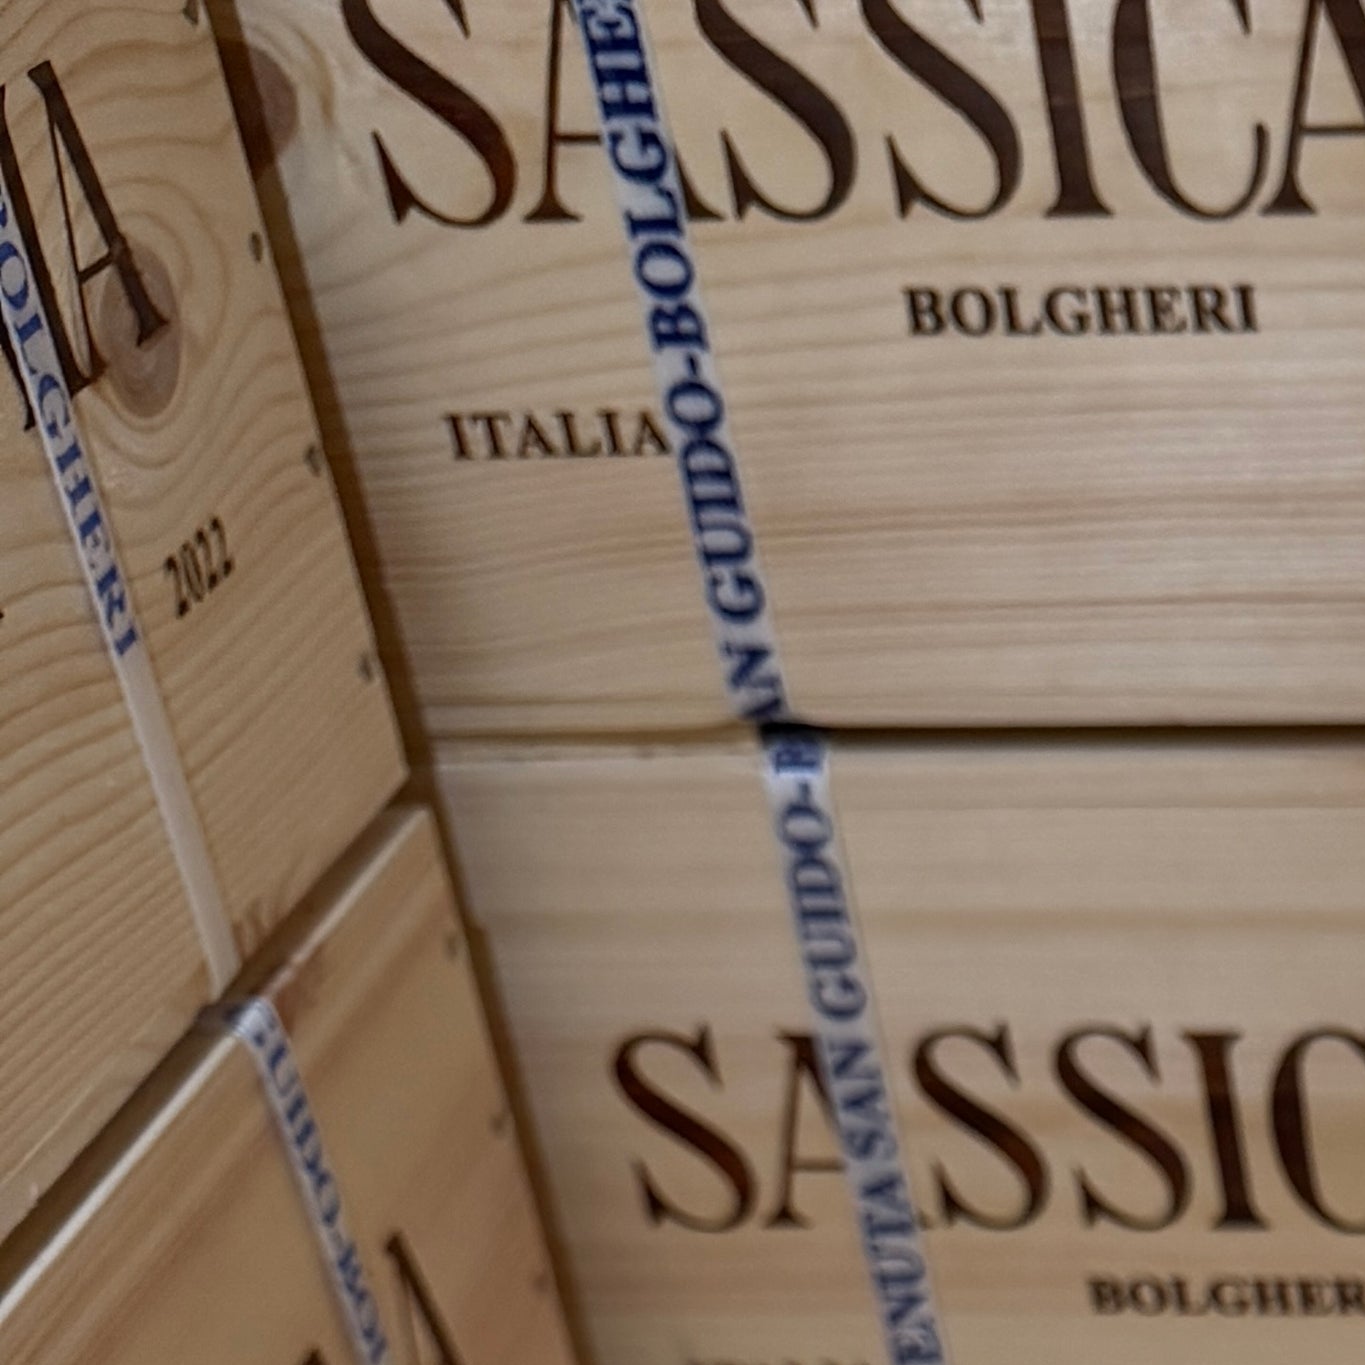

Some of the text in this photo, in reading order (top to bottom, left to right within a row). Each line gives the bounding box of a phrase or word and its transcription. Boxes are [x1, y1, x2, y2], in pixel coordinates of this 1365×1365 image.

[905, 284, 1260, 337] BOLGHERI
[0, 200, 138, 658] OLGHERI
[444, 411, 671, 461] ITALIA
[163, 515, 236, 618] 2022
[827, 1038, 899, 1162] SAN
